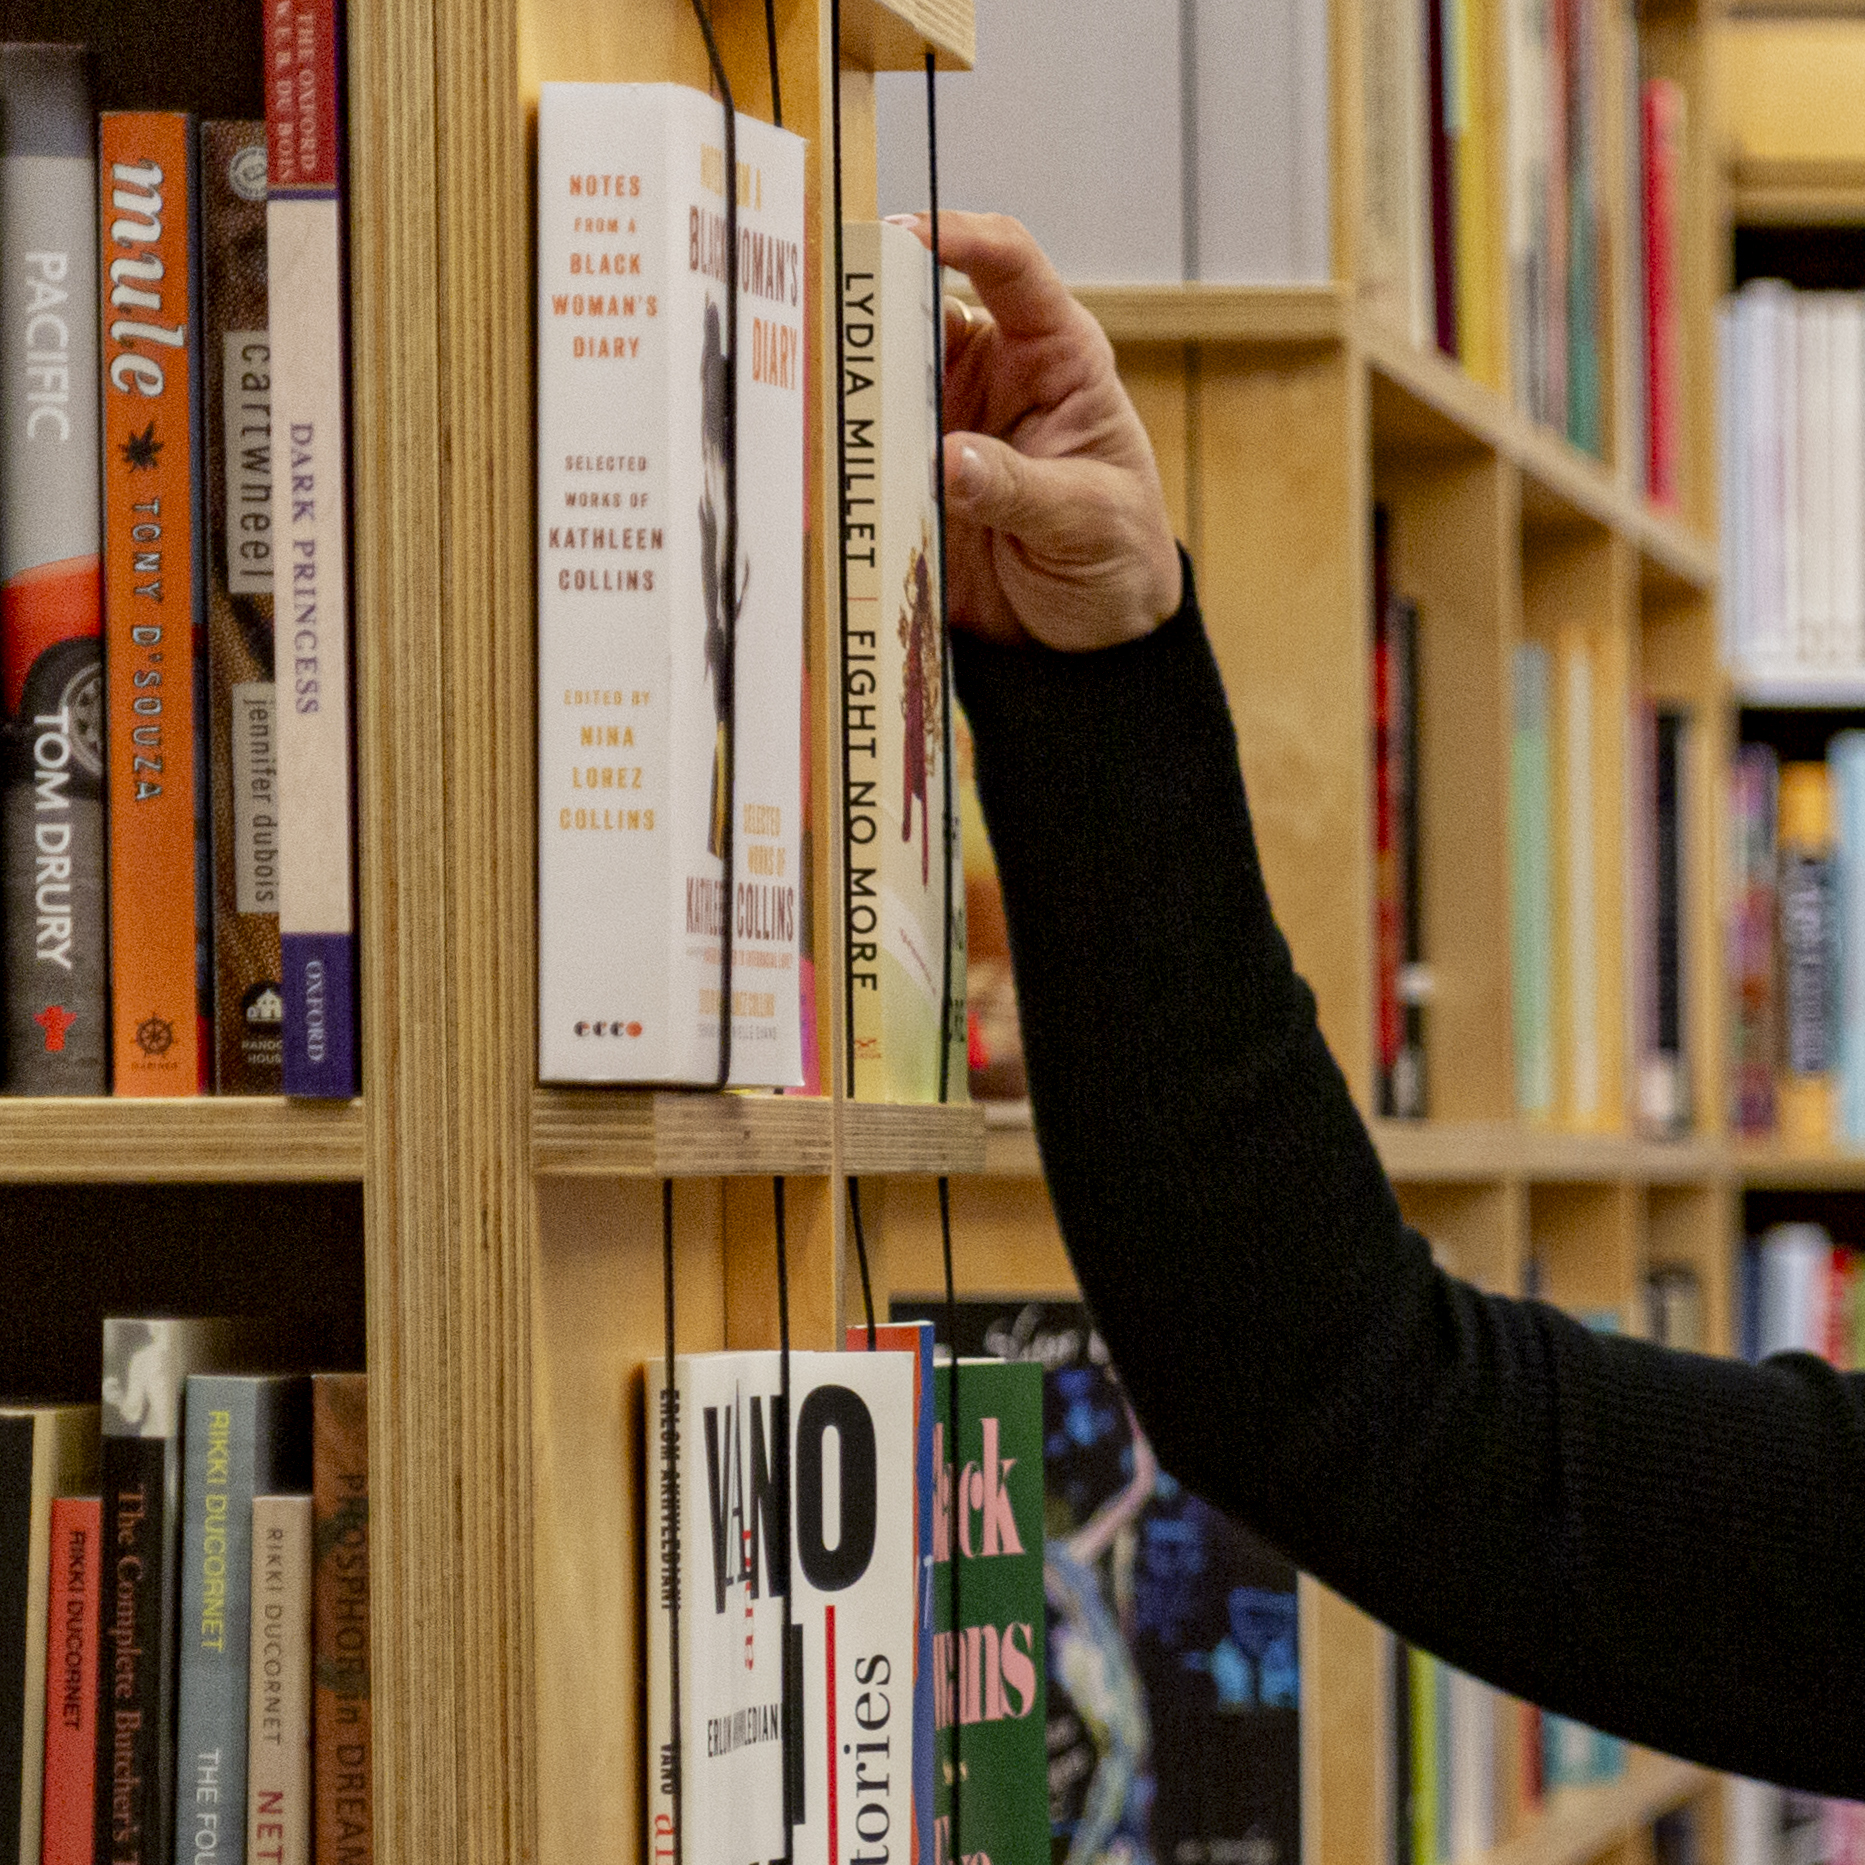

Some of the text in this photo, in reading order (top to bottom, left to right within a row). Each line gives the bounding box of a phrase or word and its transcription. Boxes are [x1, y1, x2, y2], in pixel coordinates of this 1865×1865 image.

[298, 68, 317, 172] OXFORD
[568, 174, 642, 197] NOTES
[574, 216, 637, 234] FROM A
[109, 158, 185, 398] mule
[569, 252, 642, 275] BLACK
[552, 294, 659, 317] WOMAN'S
[25, 252, 70, 441] PACIFIC
[573, 335, 640, 359] DIARY
[752, 316, 798, 391] DIARY
[564, 455, 648, 473] SELECTED
[564, 491, 649, 509] WORKS OF
[290, 422, 320, 716] DARK PRINCESS
[548, 527, 664, 550] KATHLEEN
[558, 569, 655, 593] COLLINS
[131, 496, 165, 802] TONY D'SOUZA
[844, 272, 879, 991] LYDIA MILLET FIGHT NO MORE
[563, 689, 651, 707] EDITED BY
[579, 726, 635, 747] NINA
[572, 766, 643, 790] LOREZ
[34, 706, 72, 971] TOM DRURY
[558, 807, 656, 831] COLLINS
[252, 815, 280, 904] dubois
[736, 881, 794, 942] COLLINS
[305, 960, 325, 1062] OXFORD
[116, 1484, 148, 1546] The
[200, 1409, 230, 1653] RIKKI DUCORNET
[67, 1530, 86, 1593] RIKKI
[107, 1554, 144, 1701] Complete
[262, 1526, 285, 1746] RIKKI DUCORNET
[63, 1597, 84, 1731] DUCORNET
[196, 1747, 221, 1804] THE
